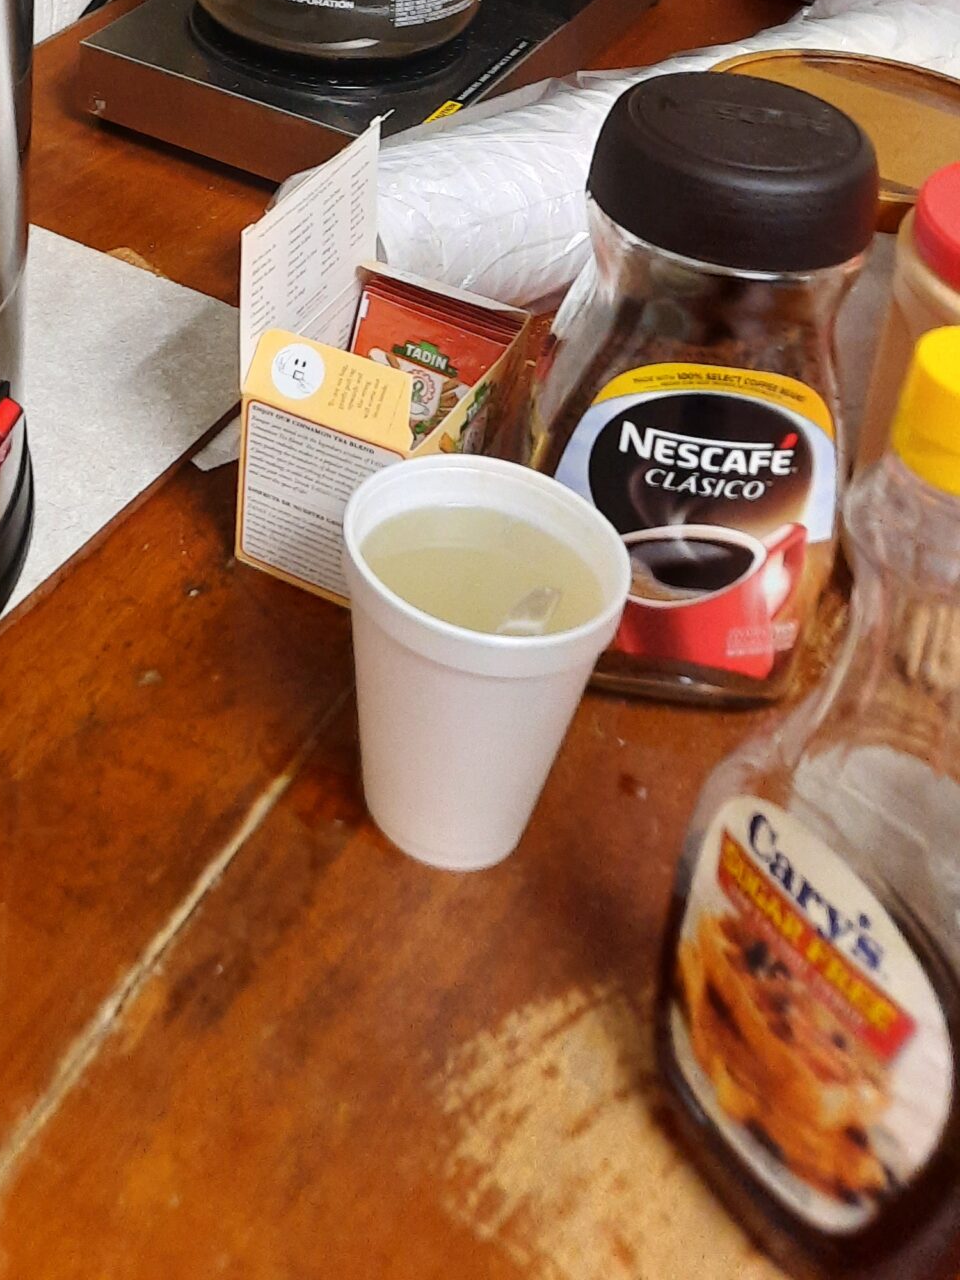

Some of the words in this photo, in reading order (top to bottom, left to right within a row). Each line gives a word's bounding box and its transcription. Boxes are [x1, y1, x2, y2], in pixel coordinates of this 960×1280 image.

[405, 343, 449, 370] TADIN
[706, 373, 741, 382] SELECT
[744, 378, 778, 392] COFFEE
[618, 420, 798, 476] NESCAFÉ
[644, 468, 766, 501] CLÁSICO
[748, 813, 883, 971] Cary's
